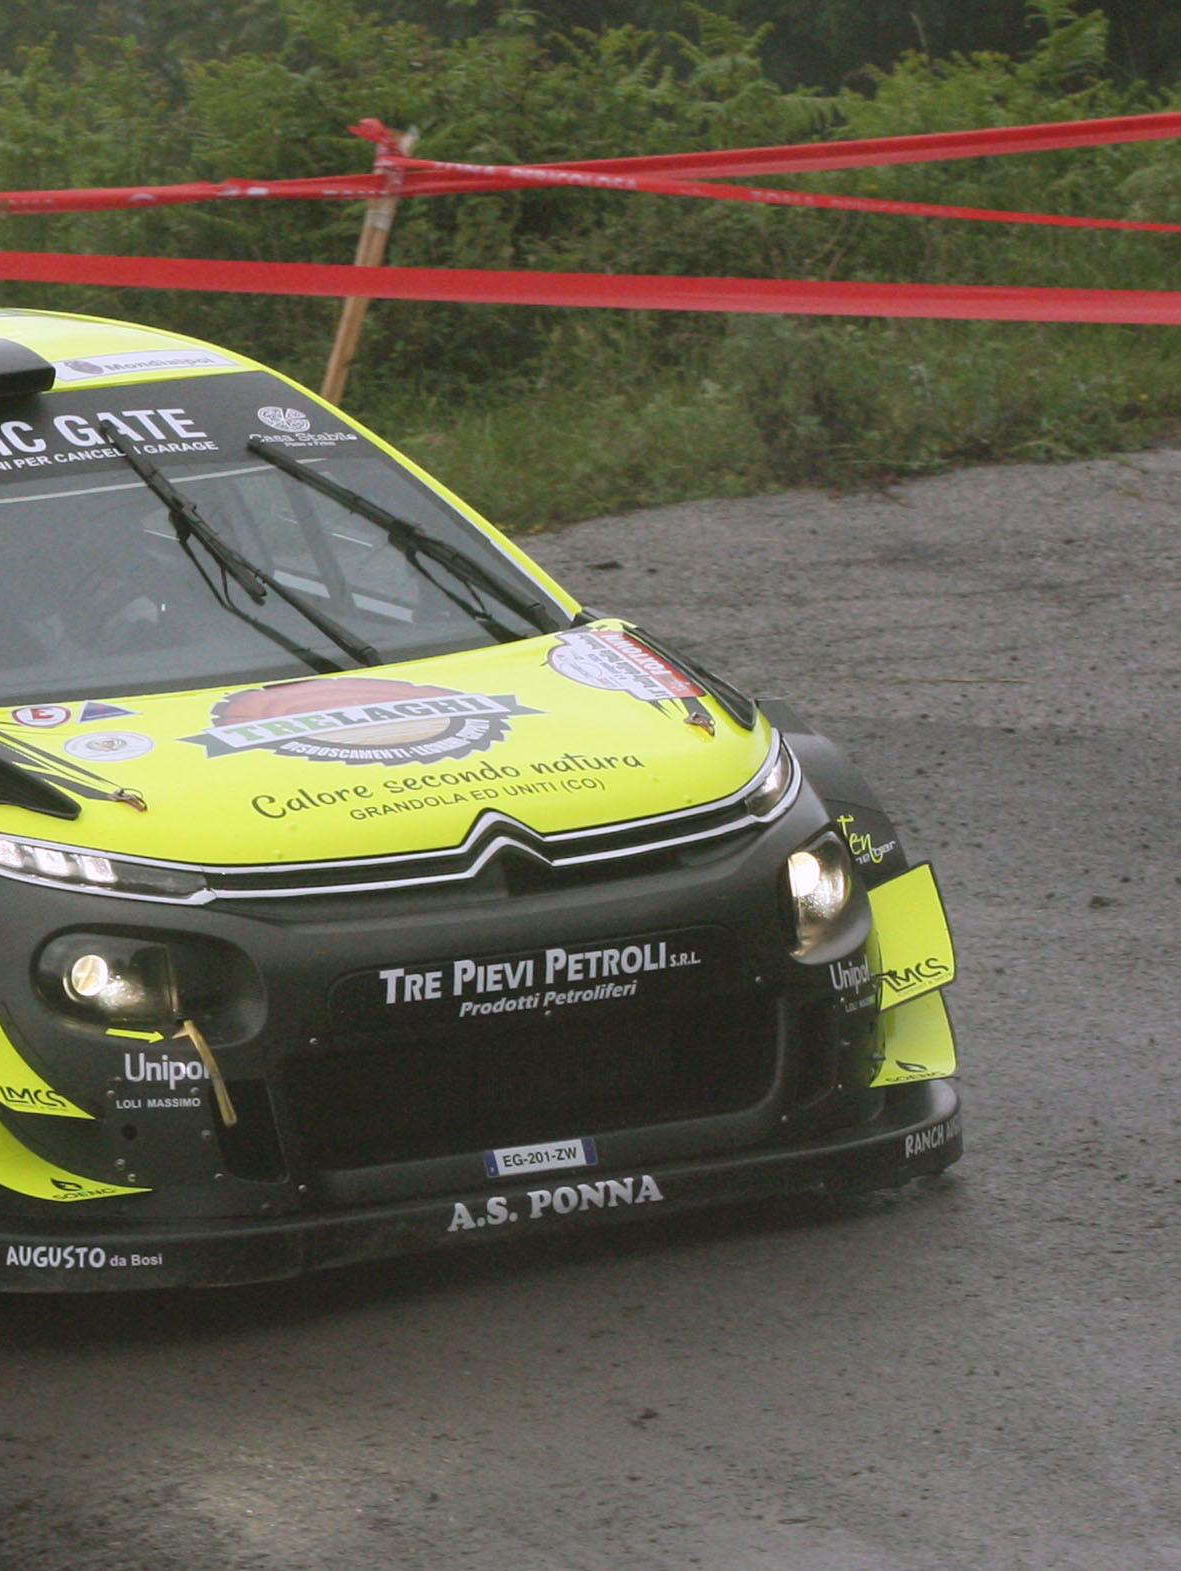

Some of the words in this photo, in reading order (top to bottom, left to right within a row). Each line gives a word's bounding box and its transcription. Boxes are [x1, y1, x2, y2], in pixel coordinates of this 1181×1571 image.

[53, 408, 208, 447] GATE
[16, 455, 50, 471] PER
[54, 446, 141, 465] CANCELI
[143, 441, 219, 457] GARAGE
[222, 697, 496, 742] TRELAGHI
[251, 785, 374, 820] Calore
[383, 761, 521, 795] secondo
[531, 753, 646, 776] natura
[349, 791, 466, 821] GRANDOLA
[474, 786, 498, 801] ED
[502, 779, 559, 798] UNITI
[563, 776, 606, 792] (CO)
[459, 993, 539, 1018] Prodotti
[543, 980, 637, 1008] Petroliferi
[116, 1100, 141, 1109] LOLI
[147, 1098, 201, 1108] MASSIMO
[502, 1147, 578, 1168] EG-201-ZW
[905, 1125, 945, 1158] RANCH
[447, 1197, 519, 1232] A.S.
[527, 1175, 664, 1219] PONNA
[6, 1245, 106, 1268] AUGUSTO
[109, 1255, 127, 1267] da
[131, 1253, 163, 1267] Bosi
